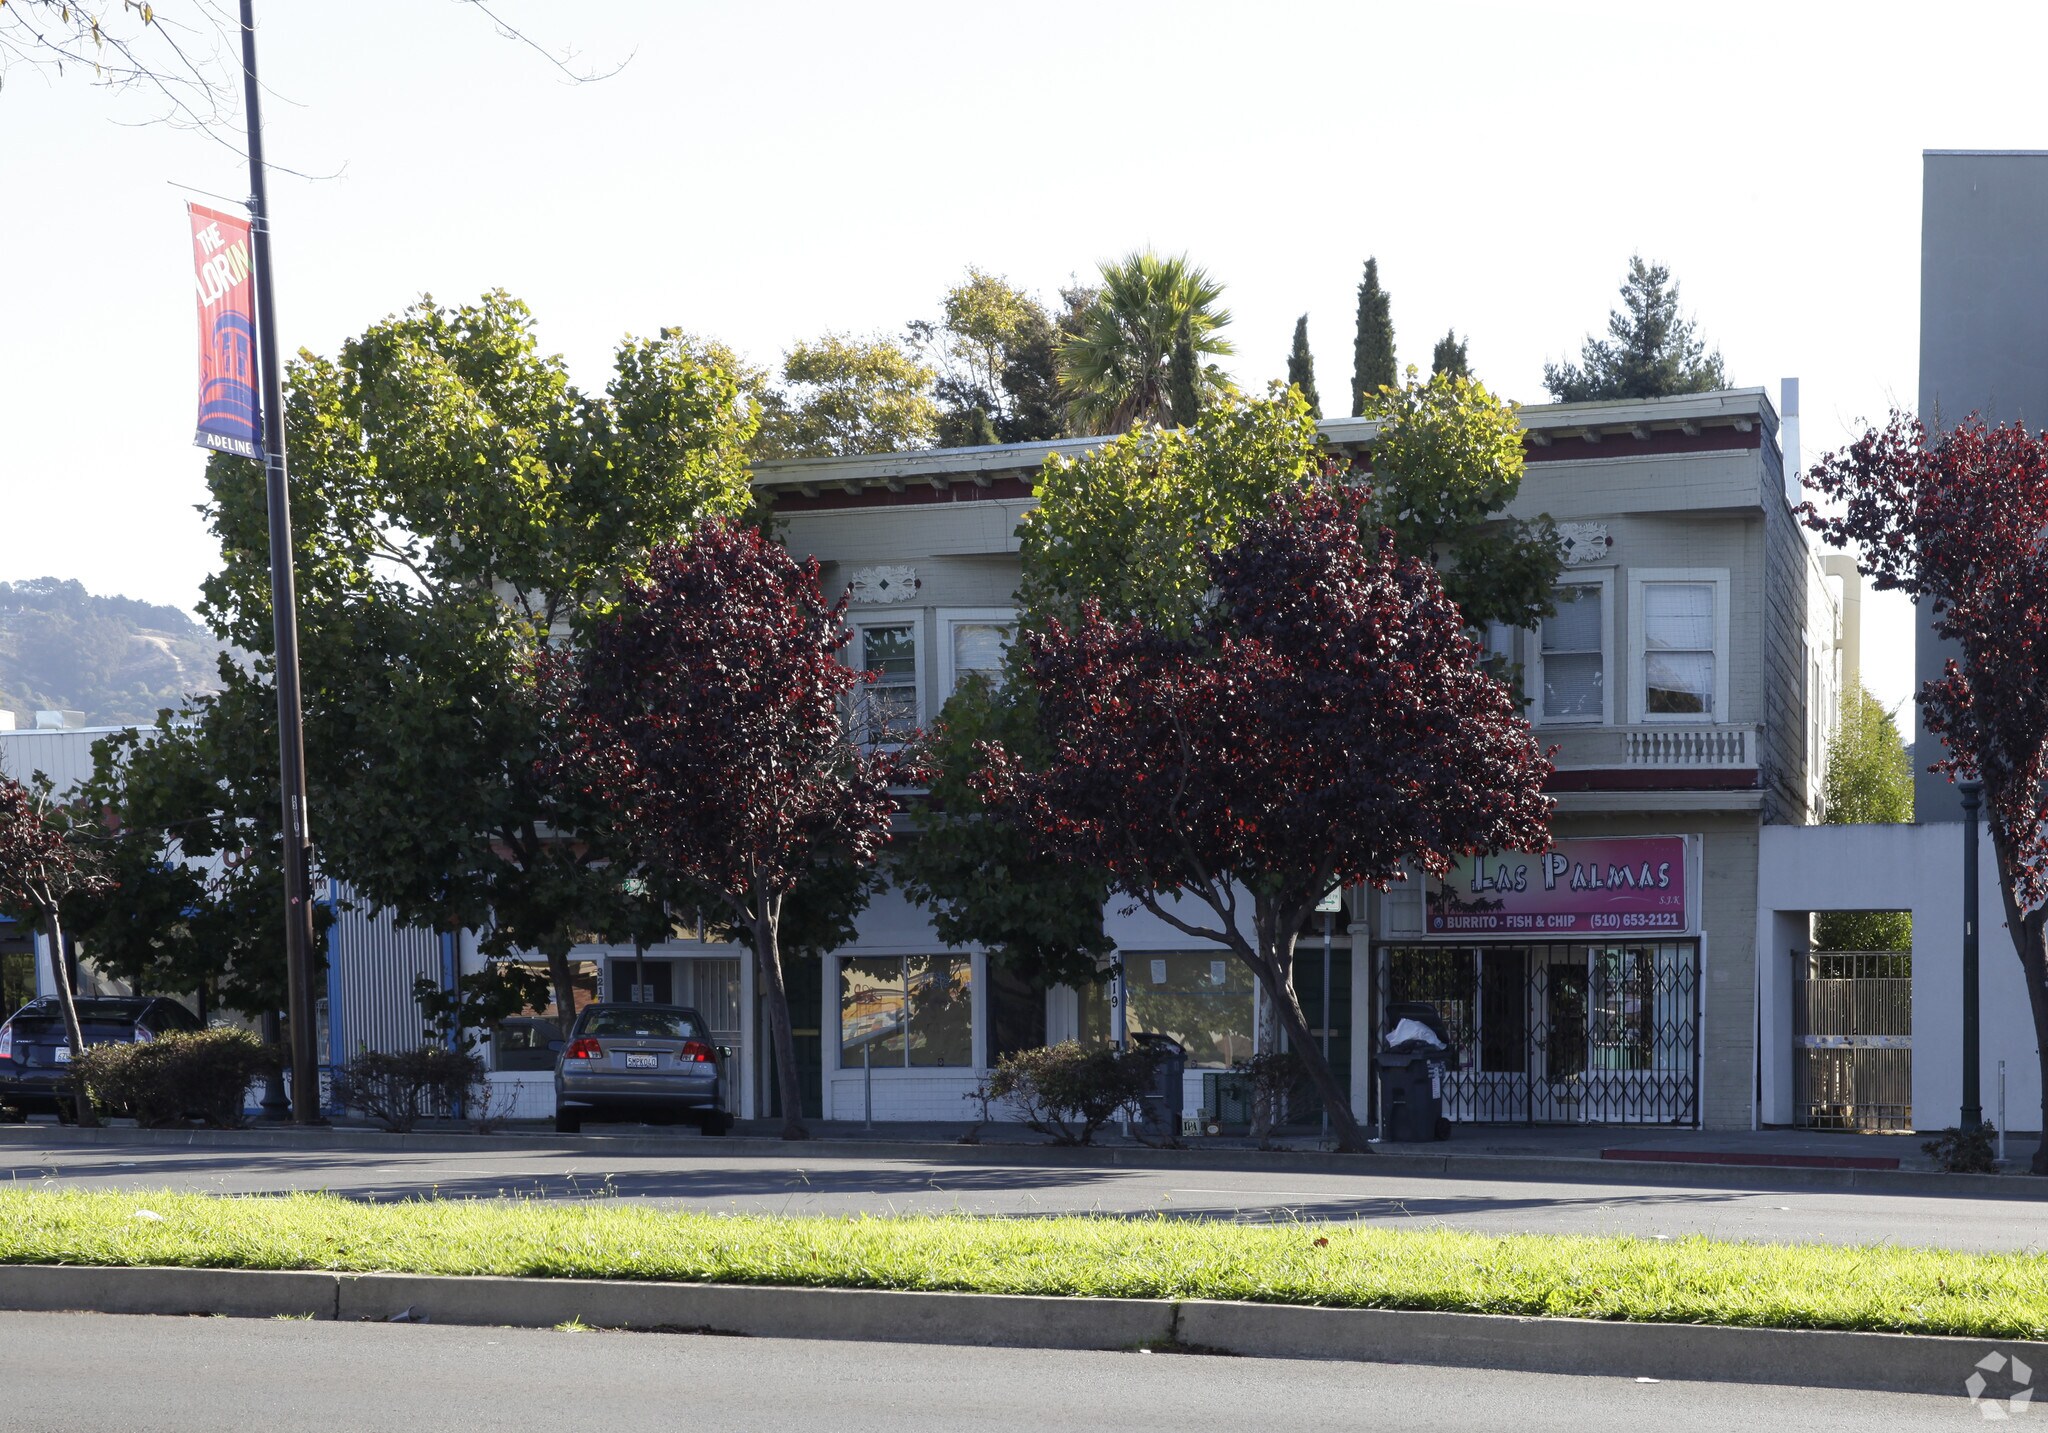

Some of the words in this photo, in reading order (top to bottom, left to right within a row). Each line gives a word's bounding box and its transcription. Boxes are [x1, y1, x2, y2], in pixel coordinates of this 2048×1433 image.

[196, 222, 225, 256] THE
[195, 239, 254, 308] LORIN
[207, 433, 253, 455] ADELINE
[1471, 854, 1527, 892] LAS
[1542, 852, 1670, 891] PALMAS
[1447, 915, 1497, 928] BURRITO
[1506, 915, 1533, 928] FISH
[1535, 915, 1545, 928] &
[1547, 915, 1576, 928] CHIP
[1590, 914, 1621, 929] (510)
[1623, 913, 1679, 927] 653-2121
[1184, 1121, 1198, 1131] IPA
